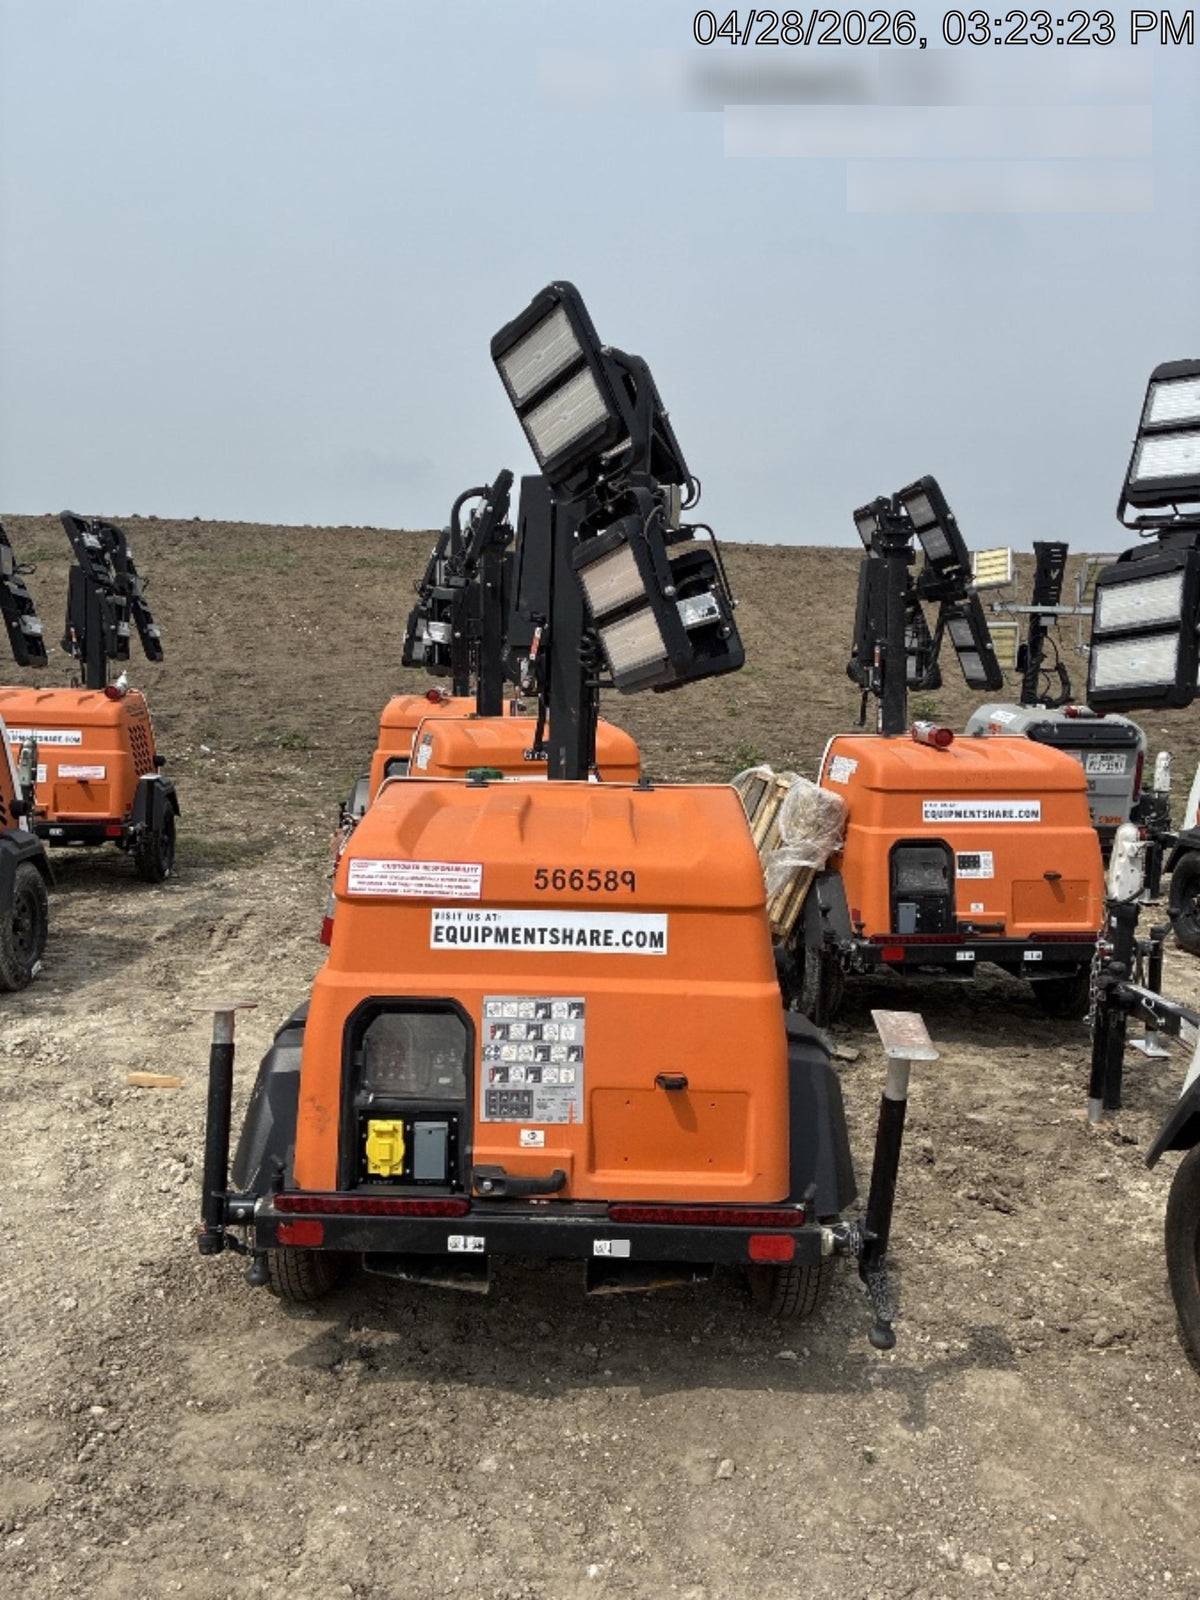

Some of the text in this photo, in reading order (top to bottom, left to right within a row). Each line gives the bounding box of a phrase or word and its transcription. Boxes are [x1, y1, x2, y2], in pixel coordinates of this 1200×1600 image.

[924, 809, 1039, 820] EQUIPMENTSHARE.COM
[534, 868, 635, 893] 566589
[434, 911, 462, 921] VISIT
[467, 912, 481, 922] US
[433, 925, 664, 949] EQUIPMENTSHARE.COM
